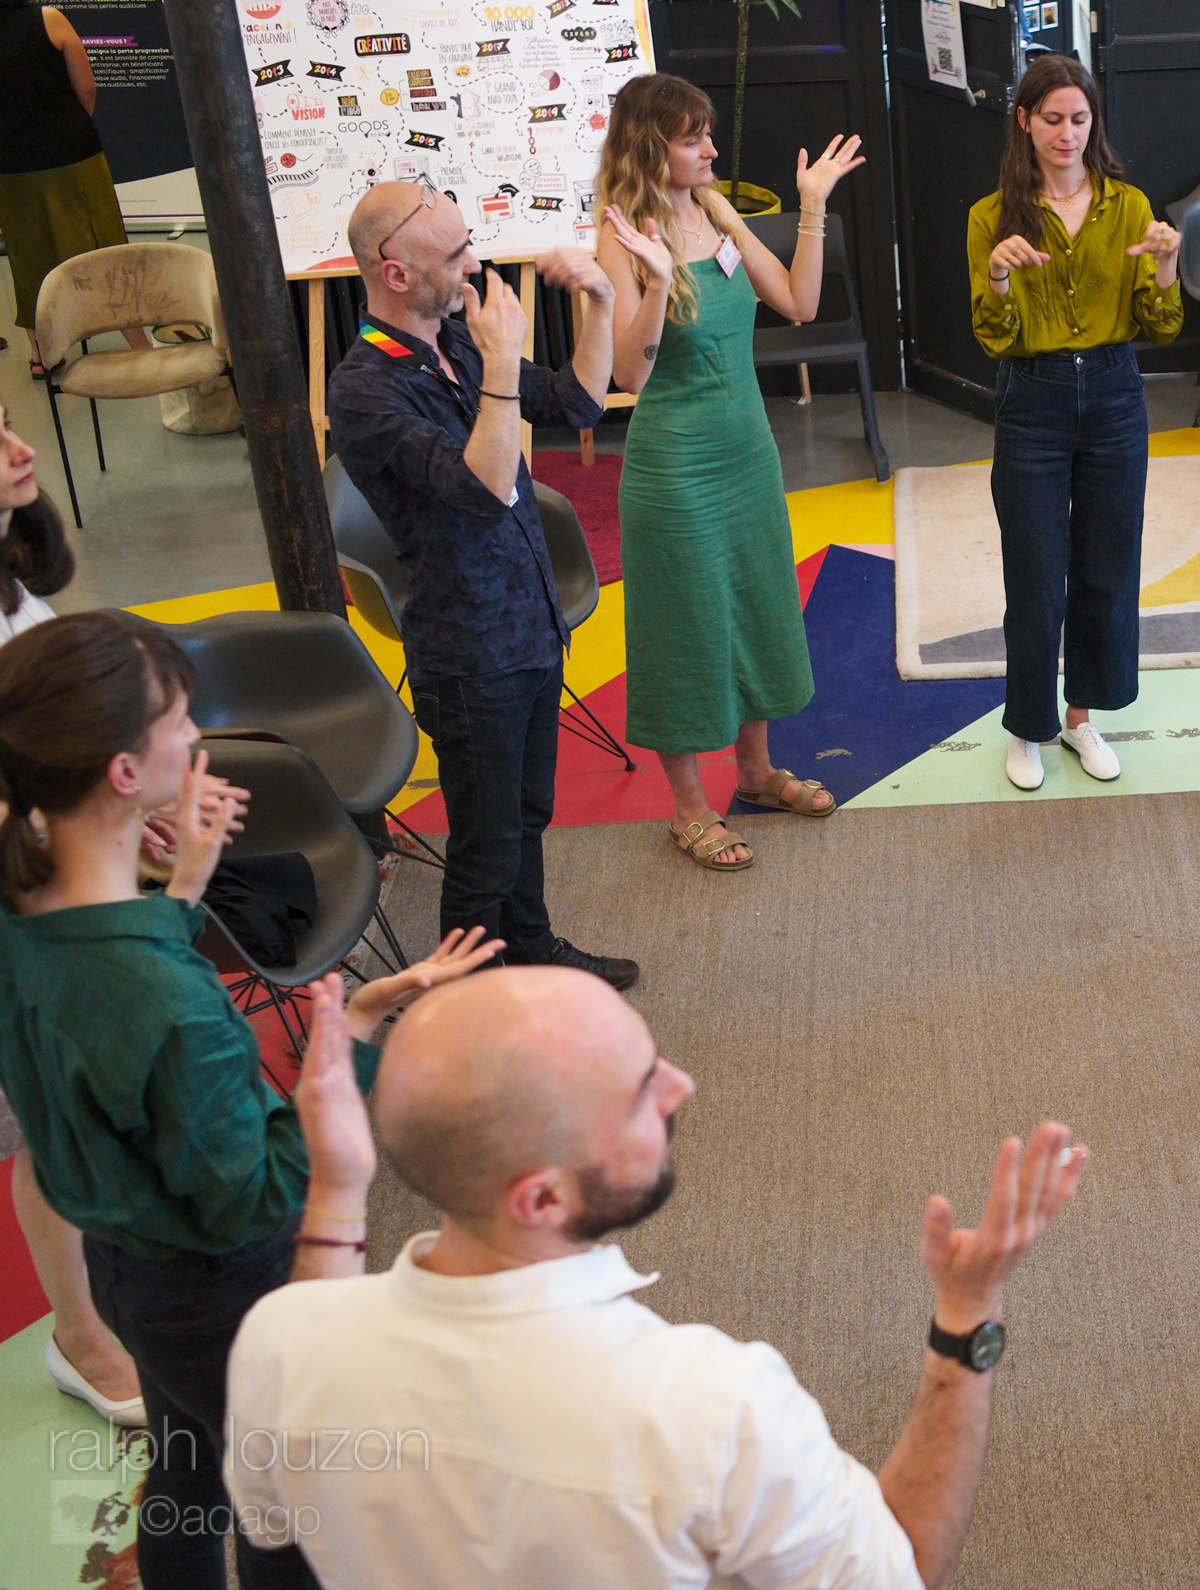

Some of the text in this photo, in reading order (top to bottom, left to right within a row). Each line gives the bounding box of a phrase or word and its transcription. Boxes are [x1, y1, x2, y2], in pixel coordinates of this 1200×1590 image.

[484, 5, 535, 20] 10 000
[521, 18, 535, 31] BOX
[243, 32, 291, 45] 'ENGAGEMENT
[564, 30, 595, 38] EXPERT
[356, 34, 408, 54] CRÉATIVITÉ
[481, 41, 505, 52] 2017
[611, 48, 634, 59] 2021
[260, 64, 285, 81] 2013
[313, 64, 337, 77] 2014
[292, 107, 326, 121] VISION
[535, 106, 559, 119] 2019
[338, 120, 389, 133] GOODS
[264, 127, 317, 140] COMMENT DÉPASSER
[411, 133, 437, 147] 2015
[290, 137, 325, 148] CONVAINCUS
[535, 197, 558, 208] 2020
